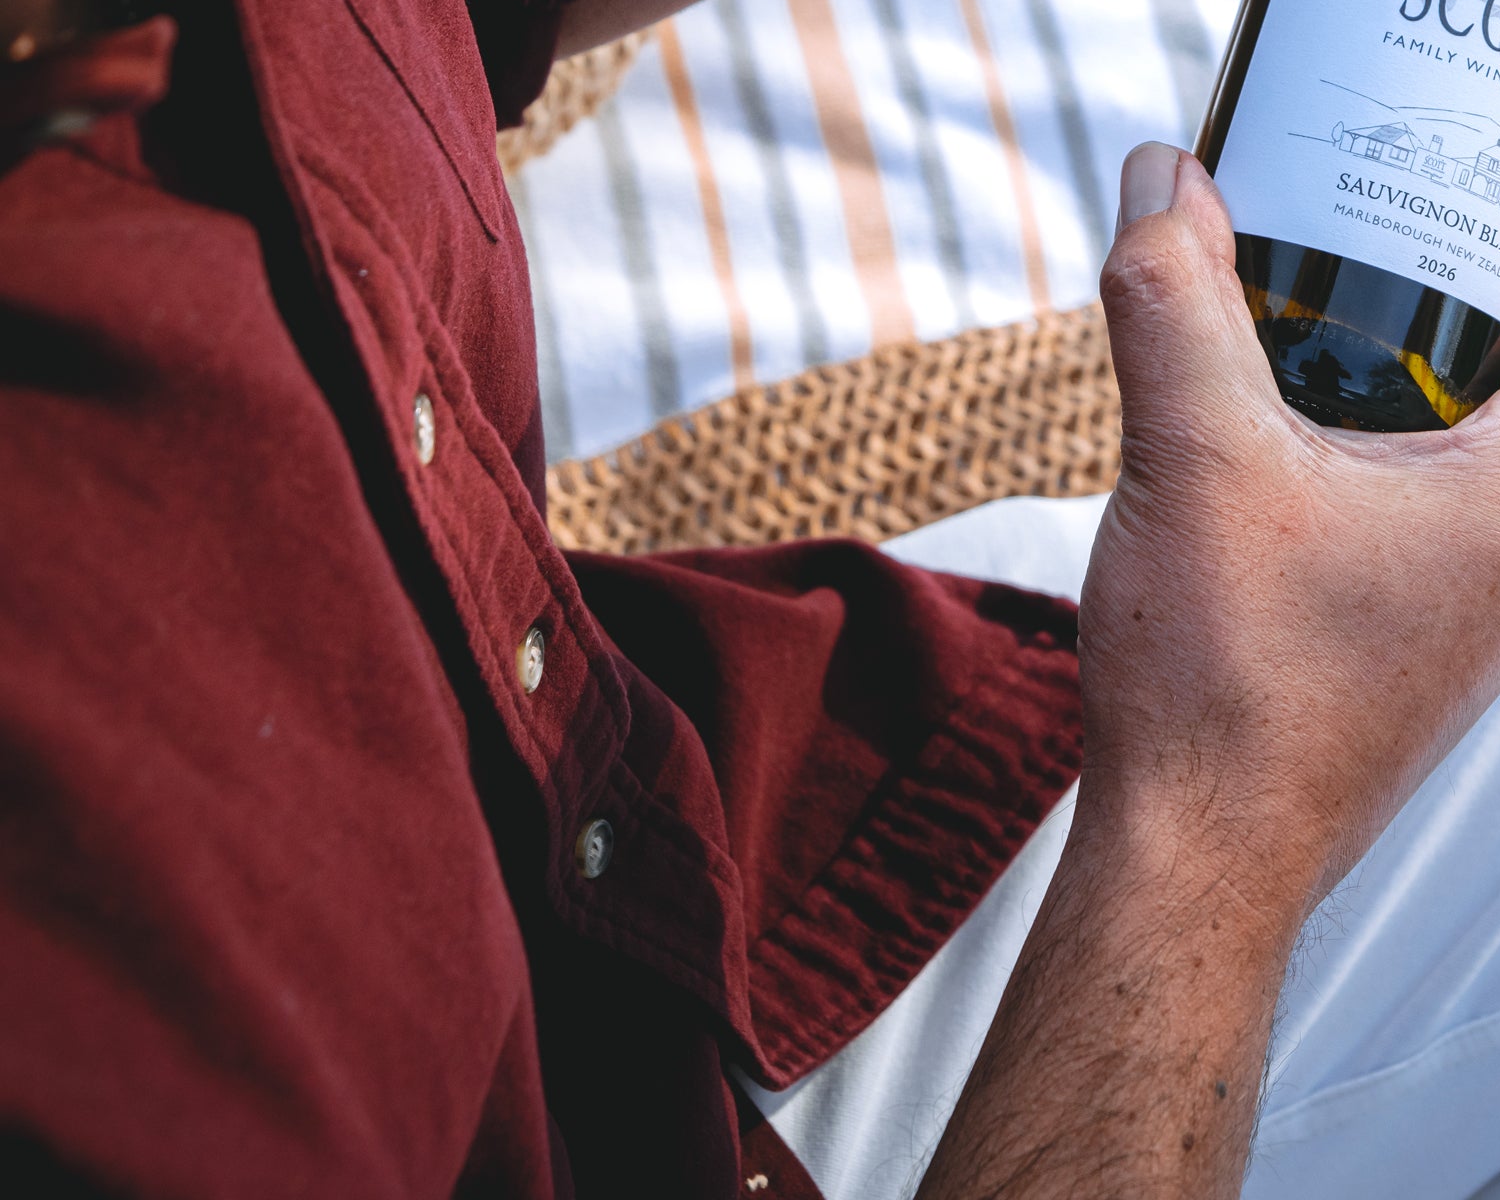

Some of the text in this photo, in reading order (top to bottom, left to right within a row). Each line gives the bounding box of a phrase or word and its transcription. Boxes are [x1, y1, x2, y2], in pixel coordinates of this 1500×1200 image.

[1383, 31, 1458, 63] FAMILY
[1423, 154, 1447, 171] SCOTT
[1336, 172, 1477, 236] SAUVIGNON
[1333, 203, 1443, 248] MARLBOROUGH
[1446, 242, 1476, 262] NEW
[1416, 255, 1457, 281] 2026
